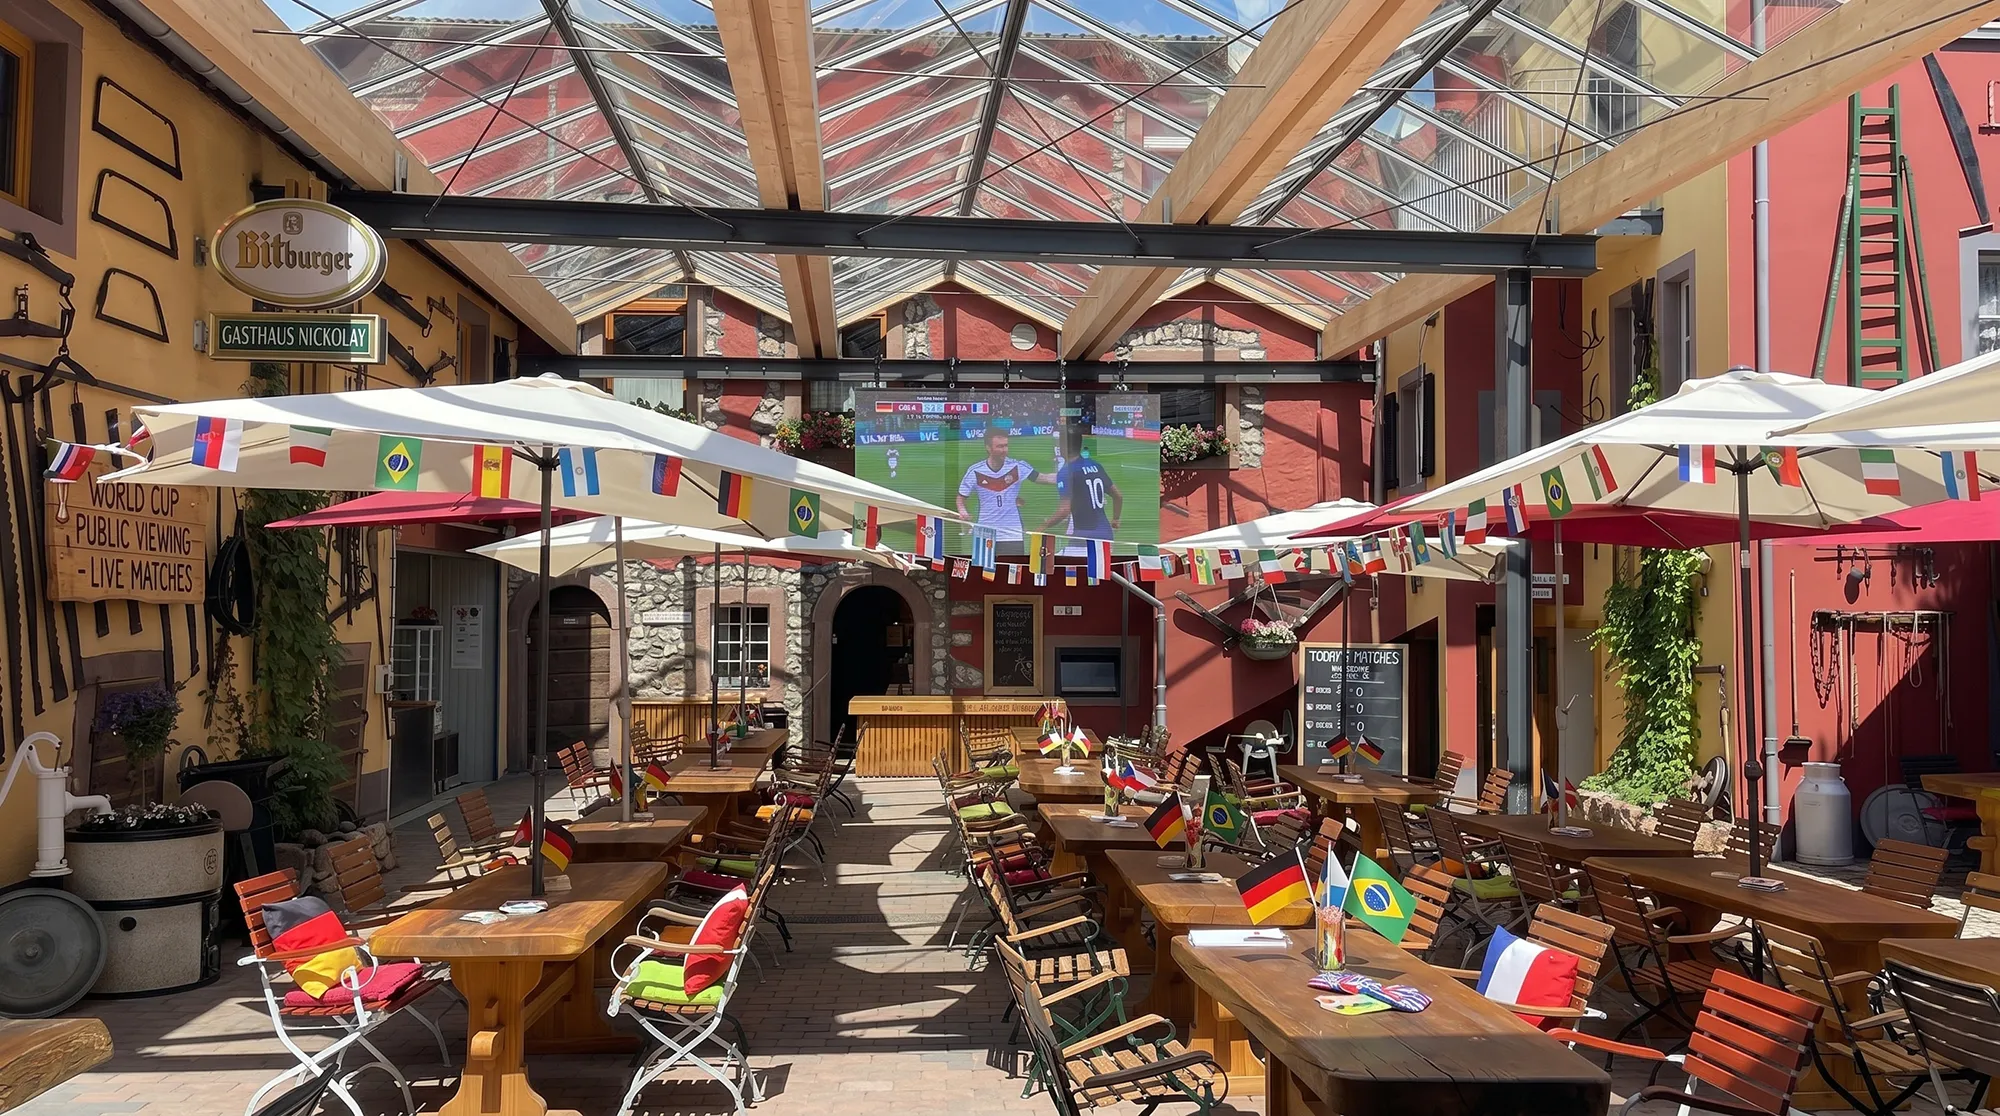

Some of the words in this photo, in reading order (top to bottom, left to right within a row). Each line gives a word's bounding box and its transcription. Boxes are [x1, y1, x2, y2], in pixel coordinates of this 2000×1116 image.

[235, 230, 353, 276] Bitburger
[222, 325, 294, 346] GASTHAUS
[299, 327, 366, 347] NICKOLAY
[88, 472, 145, 513] WORLD
[151, 485, 180, 517] CUP
[1085, 478, 1105, 510] 10
[76, 513, 130, 549] PUBLIC
[136, 520, 191, 556] VIEWING
[91, 556, 125, 589] LIVE
[131, 560, 193, 592] MATCHES
[1353, 651, 1400, 665] MATCHES
